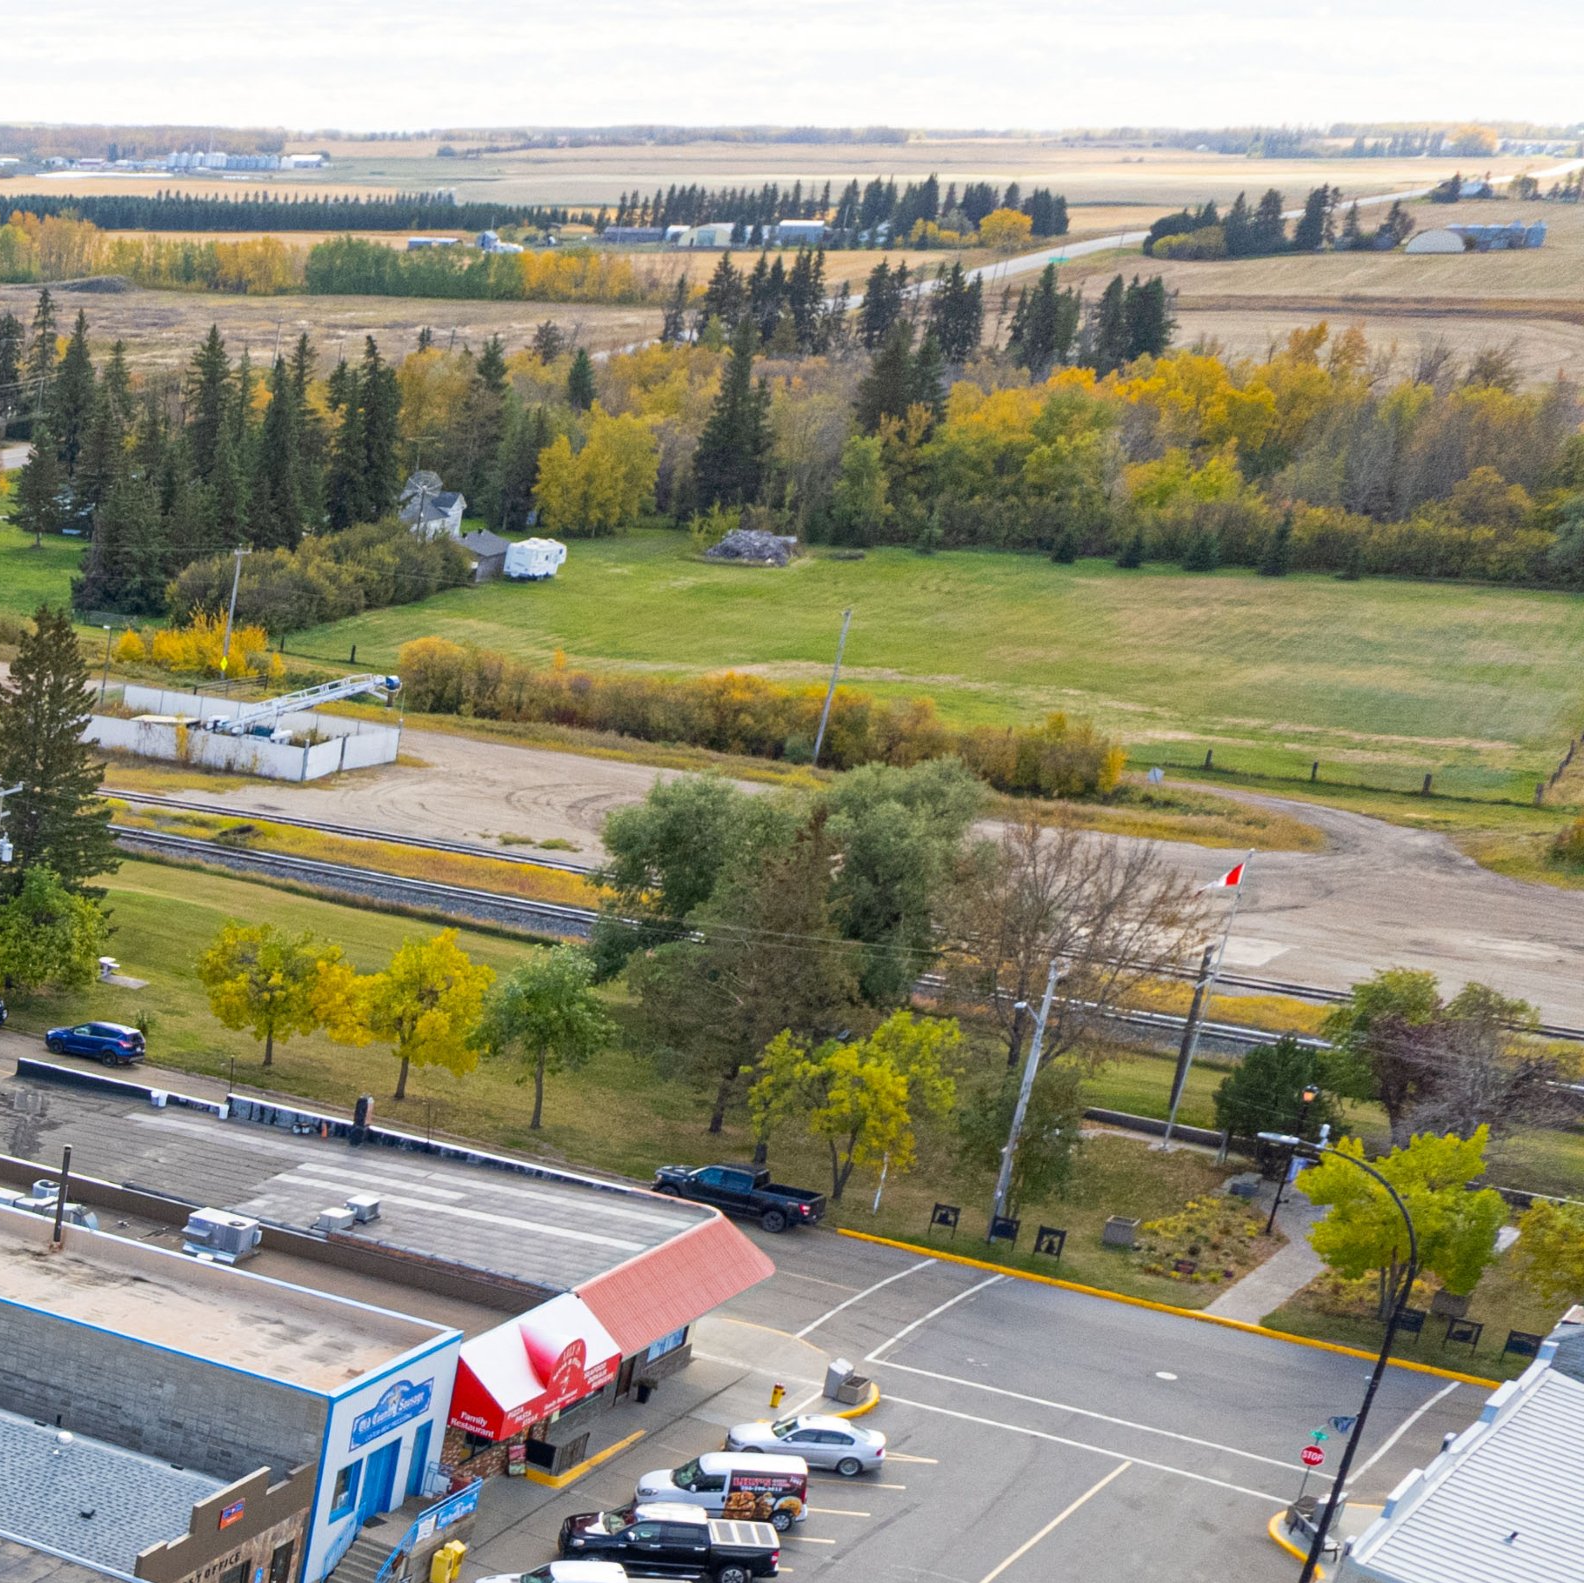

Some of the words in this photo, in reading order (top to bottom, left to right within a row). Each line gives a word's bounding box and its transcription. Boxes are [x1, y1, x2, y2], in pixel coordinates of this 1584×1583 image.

[450, 1418, 495, 1439] Restaurant
[460, 1410, 488, 1428] Family
[1302, 1450, 1324, 1462] STOP
[204, 1551, 241, 1579] OFFICE
